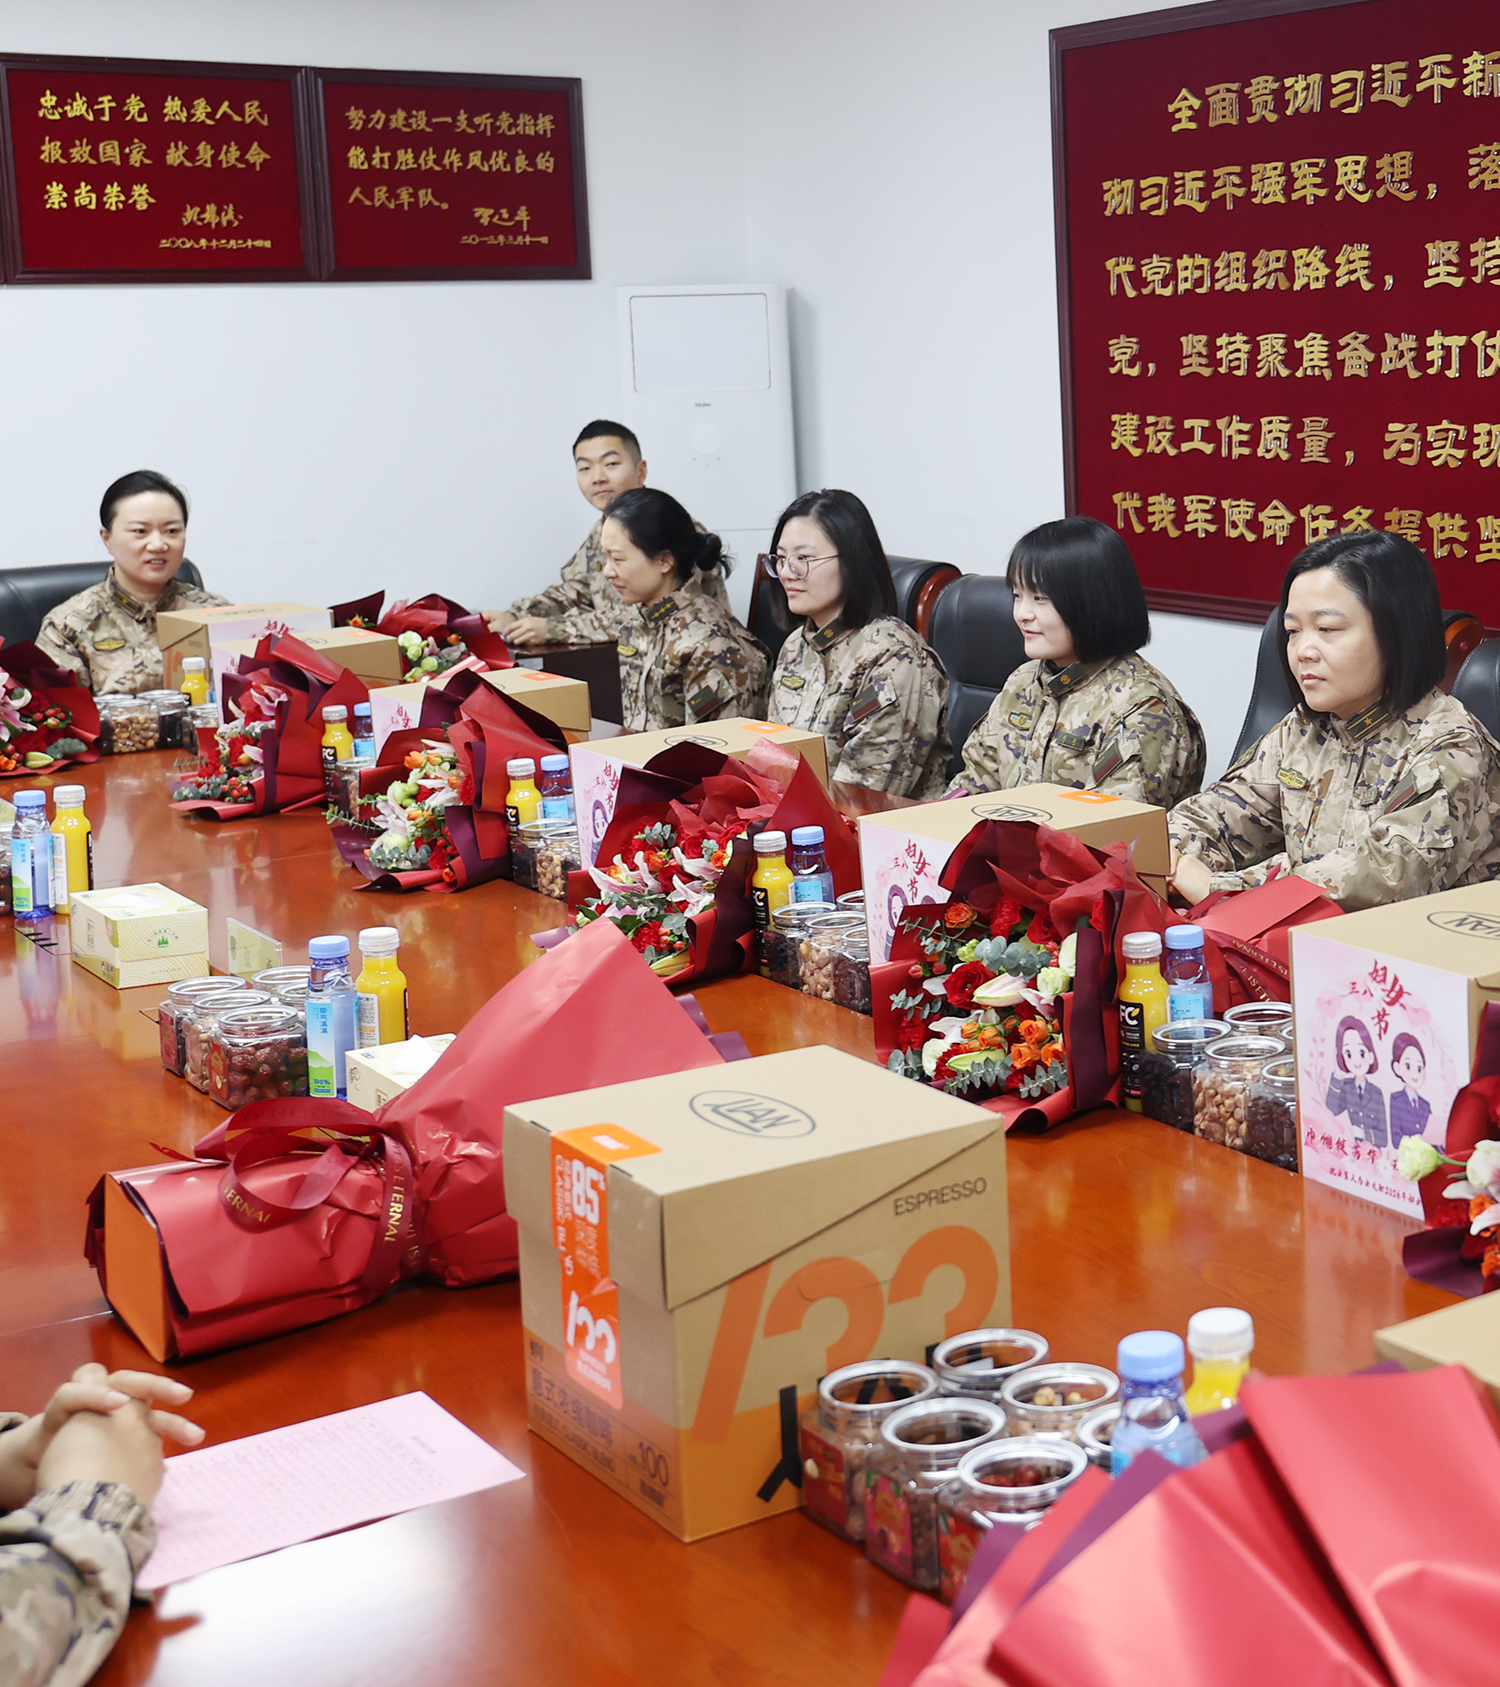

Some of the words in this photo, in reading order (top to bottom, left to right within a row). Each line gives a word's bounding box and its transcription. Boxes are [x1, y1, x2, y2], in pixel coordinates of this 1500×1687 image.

[38, 89, 148, 123] 忠诚于党
[163, 94, 269, 126] 热爱人民
[345, 106, 556, 138] 努力建设一支听党指挥
[39, 135, 153, 167] 报效国家
[166, 140, 271, 172] 献身使命
[347, 145, 555, 174] 能打胜仗作风优良的
[43, 181, 156, 211] 崇尚荣誉
[348, 186, 449, 211] 人民军队。
[893, 1176, 988, 1216] ESPRESSO
